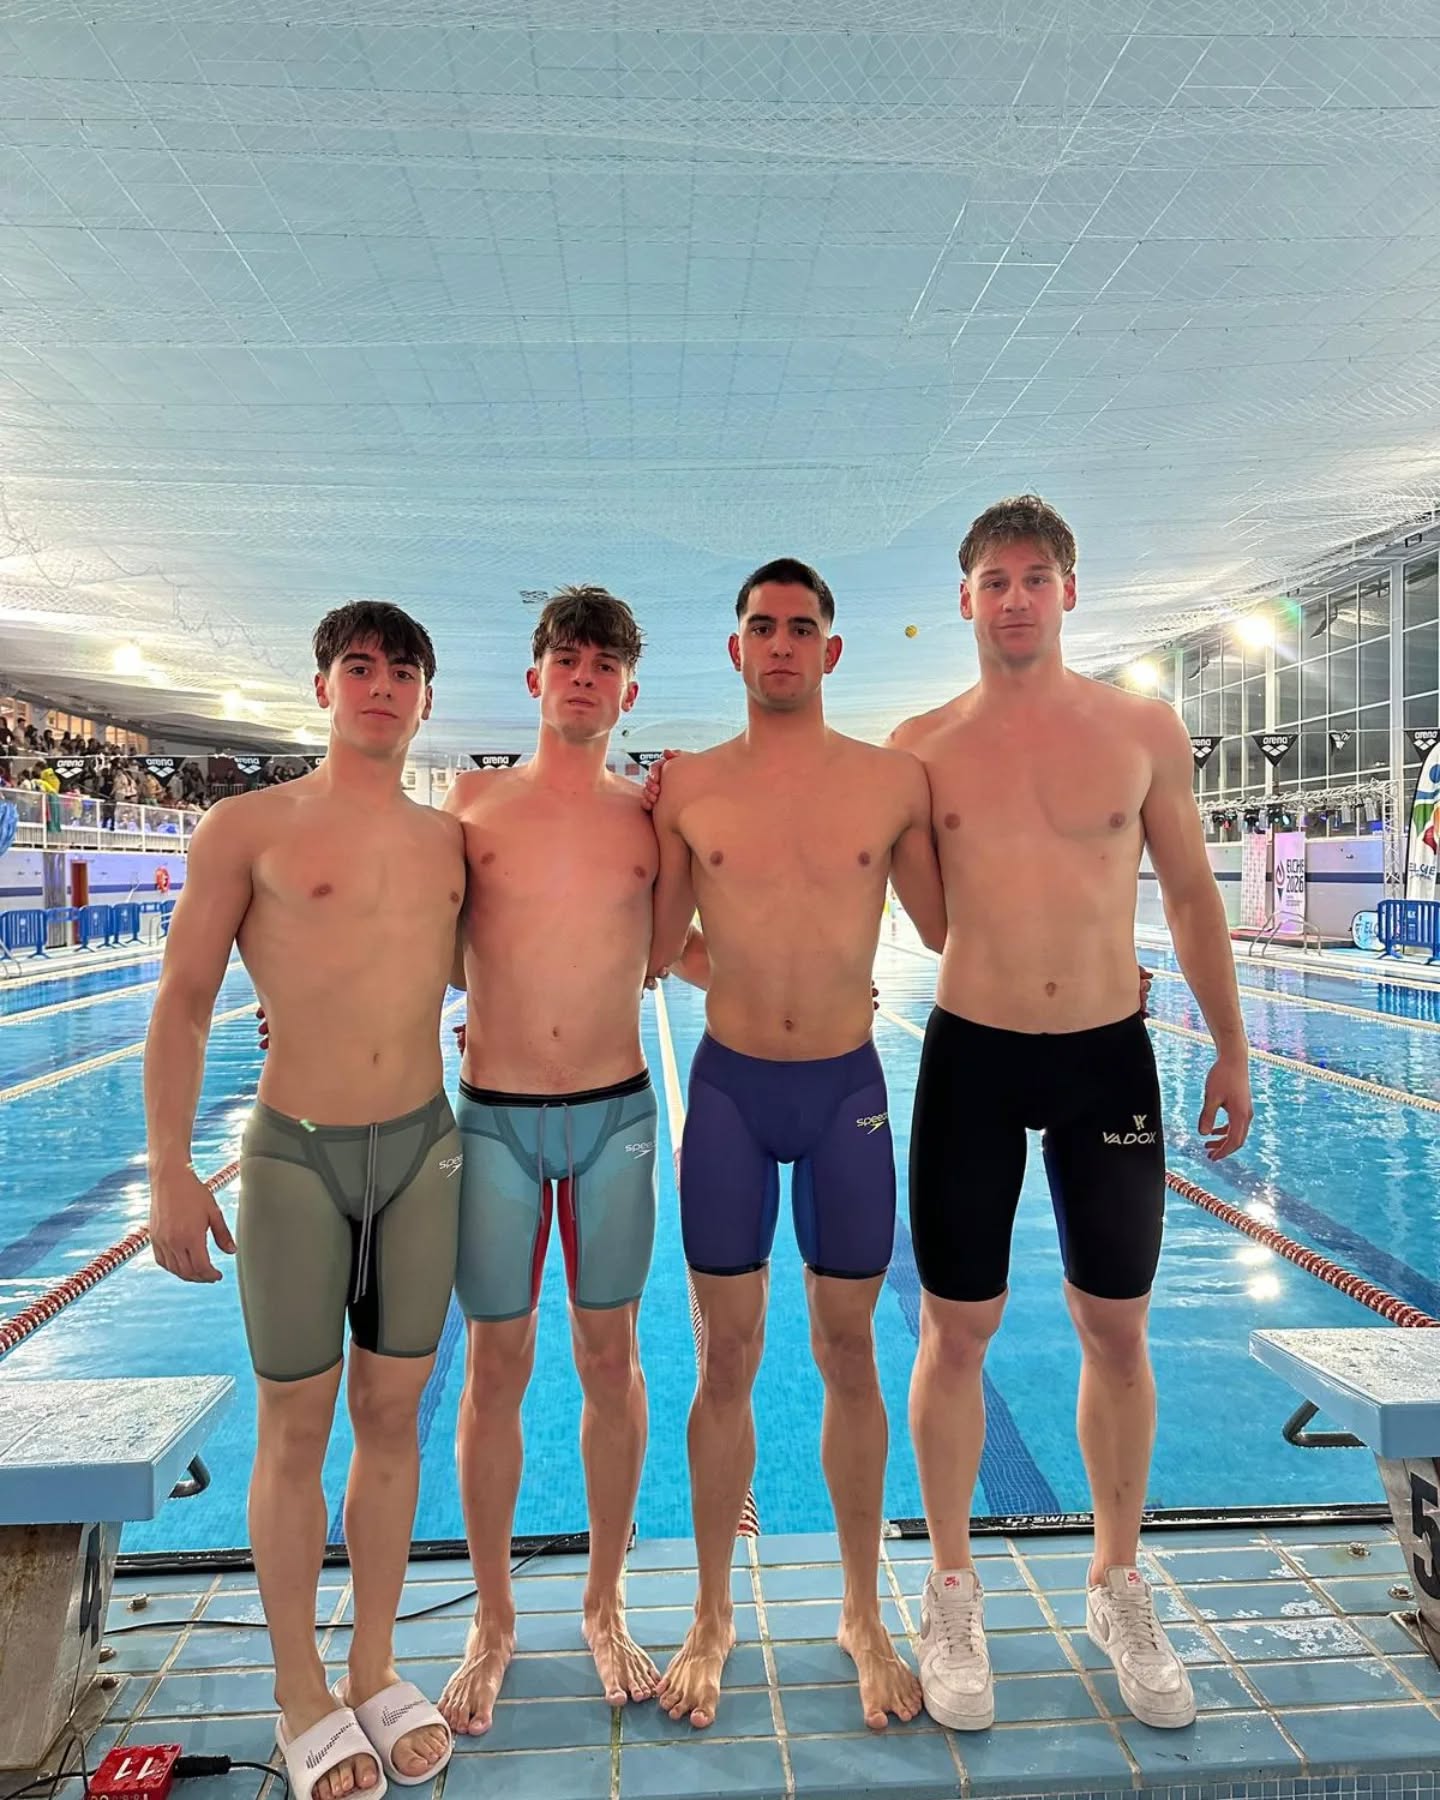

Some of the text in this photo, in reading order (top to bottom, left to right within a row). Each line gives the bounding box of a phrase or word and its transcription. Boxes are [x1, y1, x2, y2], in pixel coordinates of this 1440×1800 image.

[1414, 731, 1438, 739] arena
[1191, 738, 1212, 746] rena
[1263, 736, 1288, 744] arena
[57, 759, 84, 768] arena
[146, 758, 174, 767] arena
[482, 756, 509, 765] arena
[1286, 875, 1304, 893] 2026
[1102, 1131, 1157, 1145] VADOX
[1410, 1472, 1440, 1599] 5
[113, 1757, 155, 1781] 11
